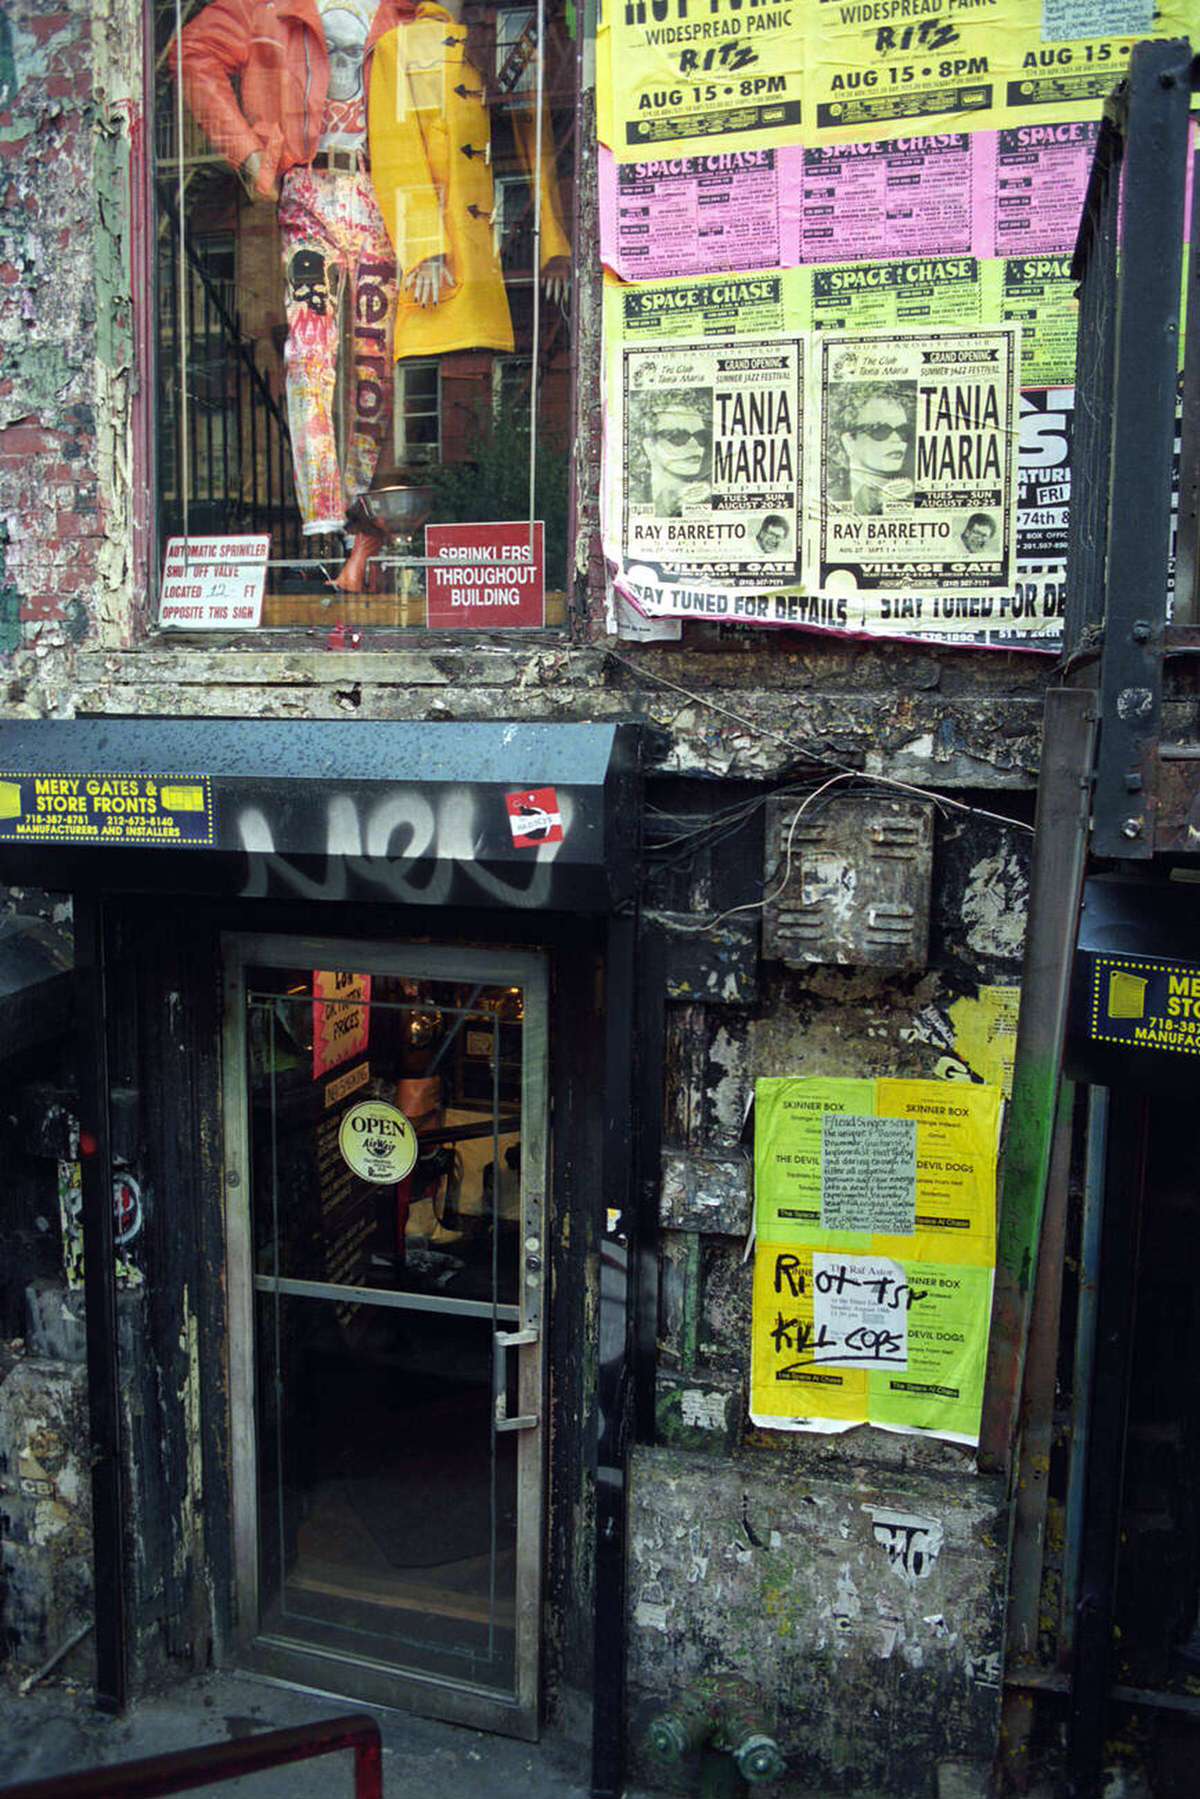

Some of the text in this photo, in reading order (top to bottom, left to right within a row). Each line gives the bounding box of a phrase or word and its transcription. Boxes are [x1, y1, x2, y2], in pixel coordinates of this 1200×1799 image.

[840, 0, 942, 24] WIDESPREAD
[646, 19, 741, 46] WIDESPREAD
[747, 9, 792, 32] PANIC
[875, 19, 960, 53] RITZ
[679, 41, 759, 74] RITZ
[1022, 43, 1112, 68] AUG 15
[831, 70, 878, 91] AUG
[889, 66, 915, 84] 15
[938, 57, 989, 78] 8PM
[639, 89, 683, 110] AUG
[693, 85, 717, 103] 15
[740, 76, 787, 97] 8PM
[1017, 123, 1084, 147] SPACE
[635, 159, 693, 179] SPACE
[830, 260, 972, 290] SPACE CHASE
[1023, 260, 1072, 280] SPAC
[641, 281, 773, 312] SPACE CHASE
[716, 390, 792, 436] TANIA
[919, 384, 1000, 431] TANIA
[715, 438, 794, 484] MARIA
[918, 433, 1001, 480] MARIA
[723, 493, 786, 501] TUES SUN
[920, 499, 996, 508] AUGUST 20-25
[926, 491, 993, 500] TUES SUN
[717, 501, 759, 510] AUGUST
[634, 523, 747, 541] RAY BARRETTO
[833, 521, 951, 539] RAY BARRETTO
[219, 543, 267, 557] SPRINKLER
[439, 545, 532, 561] SPRINKLERS
[193, 564, 209, 578] OFF
[214, 564, 239, 578] VALVE
[433, 566, 538, 585] THROUGHOUT
[661, 561, 796, 573] VILLAGE GATE
[860, 562, 1003, 573] VILLAGE GATE
[164, 586, 203, 599] LOCATED
[244, 585, 256, 598] FT
[451, 588, 520, 606] BUILDING
[162, 605, 254, 620] OPPOSITE THIS SIGN
[670, 590, 728, 614] TUNED
[734, 596, 769, 618] FOR
[775, 596, 848, 627] DETAILS
[35, 779, 158, 797] MERY GATES &
[36, 796, 157, 814] STORE FRONTS
[101, 826, 123, 836] AND
[125, 826, 181, 837] INSTALLERS
[1169, 975, 1200, 998] ME
[1135, 1027, 1200, 1048] MANUFAC
[783, 1101, 845, 1111] SKINNER BOX
[906, 1104, 969, 1117] SKINNER BOX
[352, 1115, 406, 1138] OPEN
[776, 1154, 820, 1166] THE DEVIL
[916, 1160, 974, 1173] DEVIL DOGS
[938, 1278, 961, 1289] BOX
[907, 1330, 934, 1340] DEVIL
